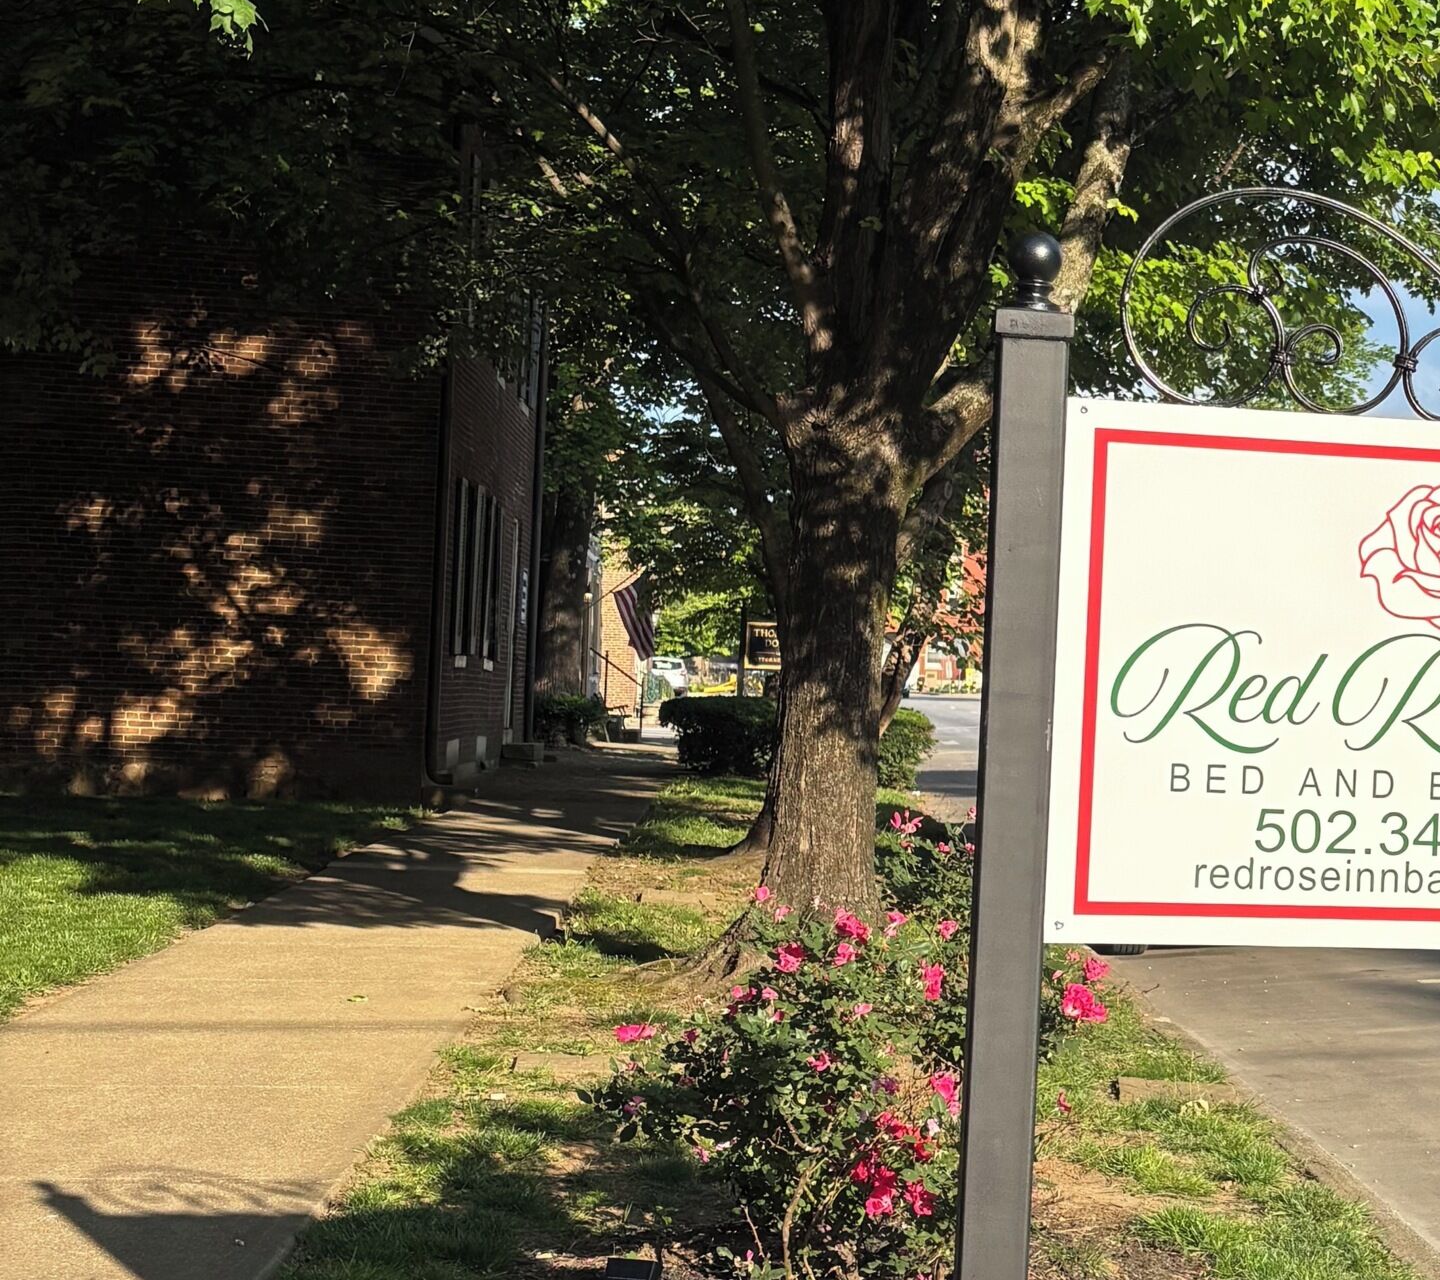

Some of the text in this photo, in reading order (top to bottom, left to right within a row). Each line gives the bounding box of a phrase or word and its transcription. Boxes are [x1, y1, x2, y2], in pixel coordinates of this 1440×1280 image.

[753, 628, 778, 638] THO
[1110, 623, 1329, 755] Red
[1170, 762, 1264, 795] BED
[1298, 767, 1394, 799] AND
